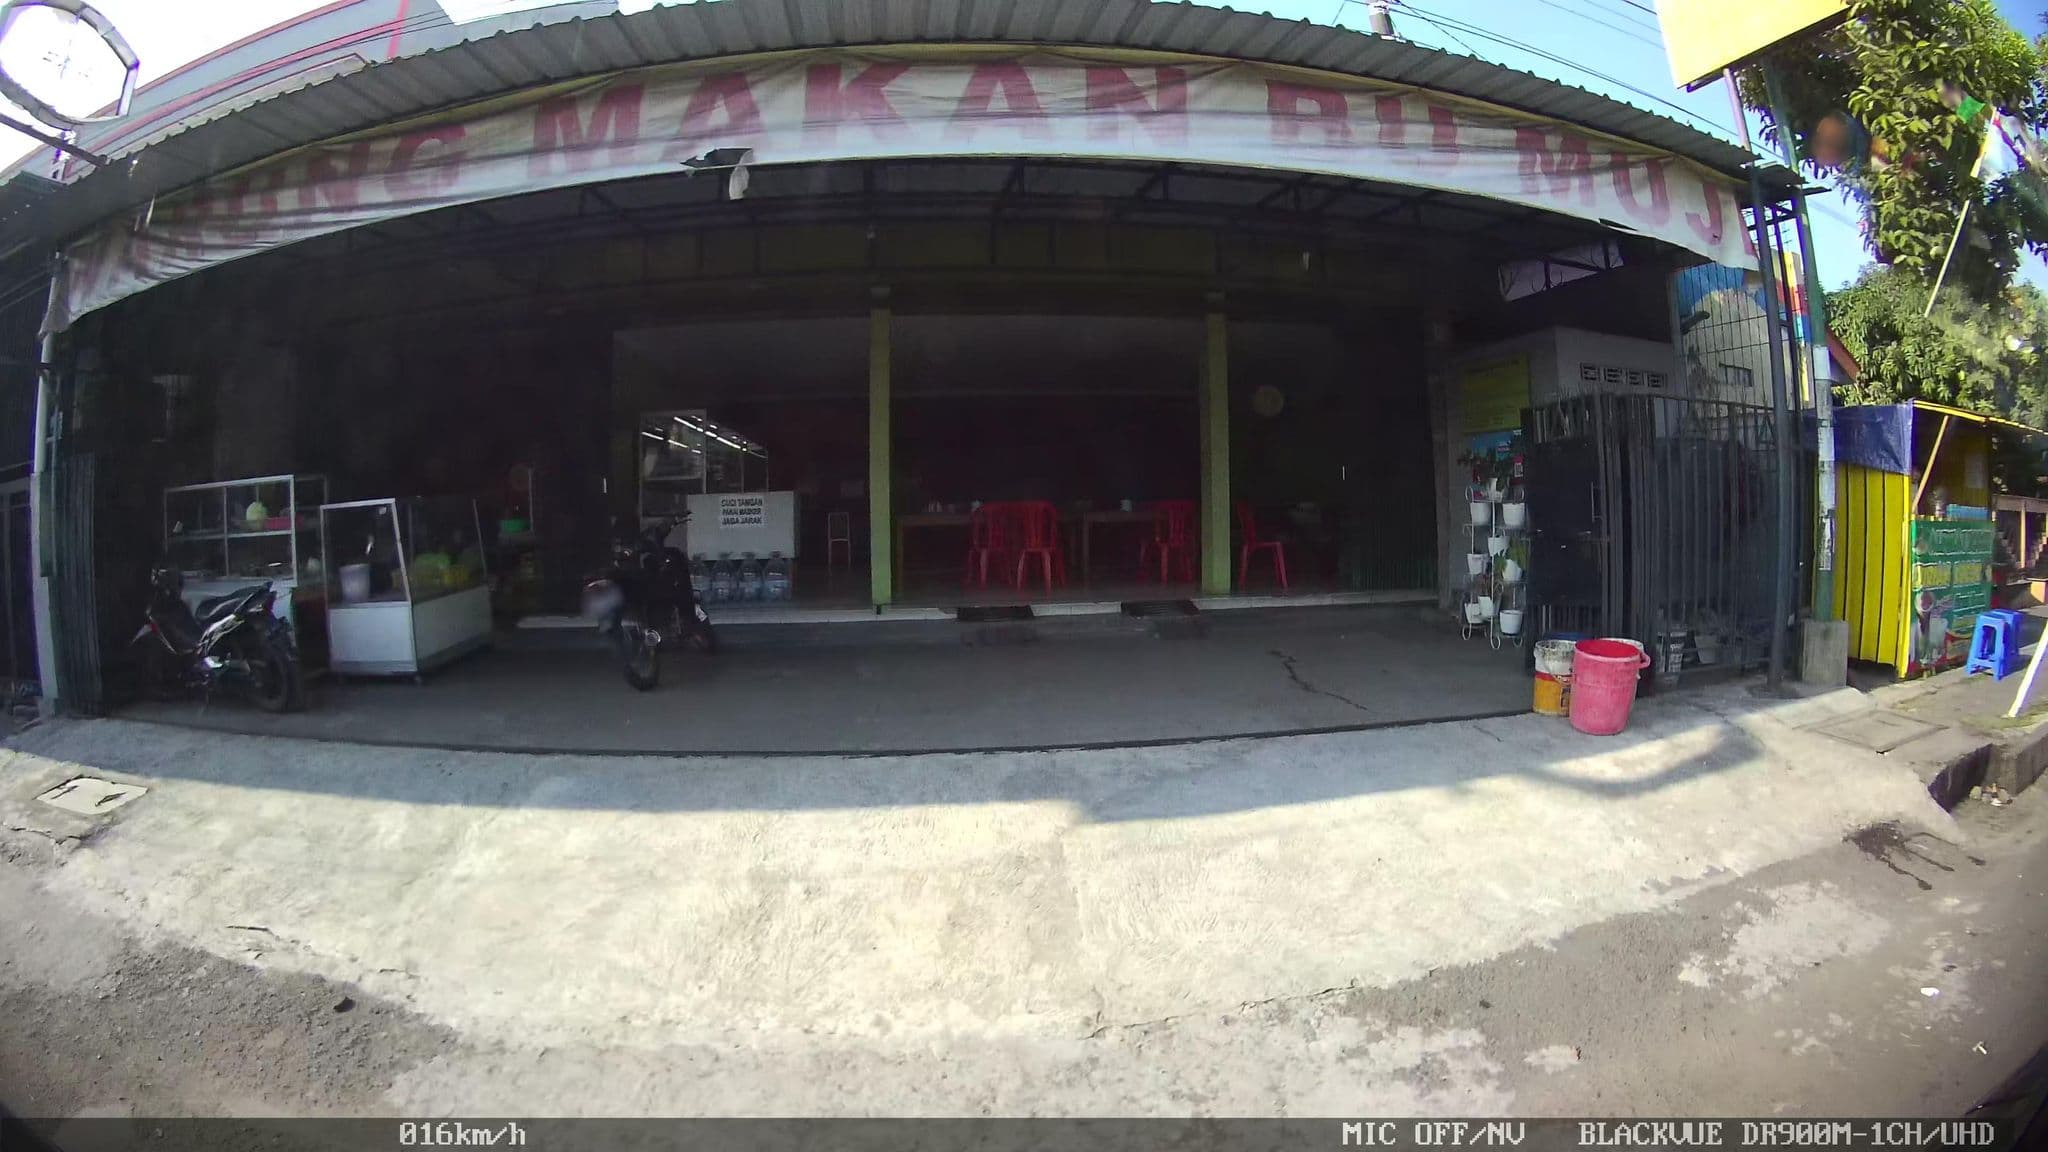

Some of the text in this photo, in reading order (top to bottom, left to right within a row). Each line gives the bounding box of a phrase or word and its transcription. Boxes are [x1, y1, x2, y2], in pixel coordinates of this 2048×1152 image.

[527, 61, 1189, 178] MAKAN
[738, 498, 763, 507] TANGAN
[739, 508, 762, 516] MASKER
[740, 517, 762, 525] JARAK
